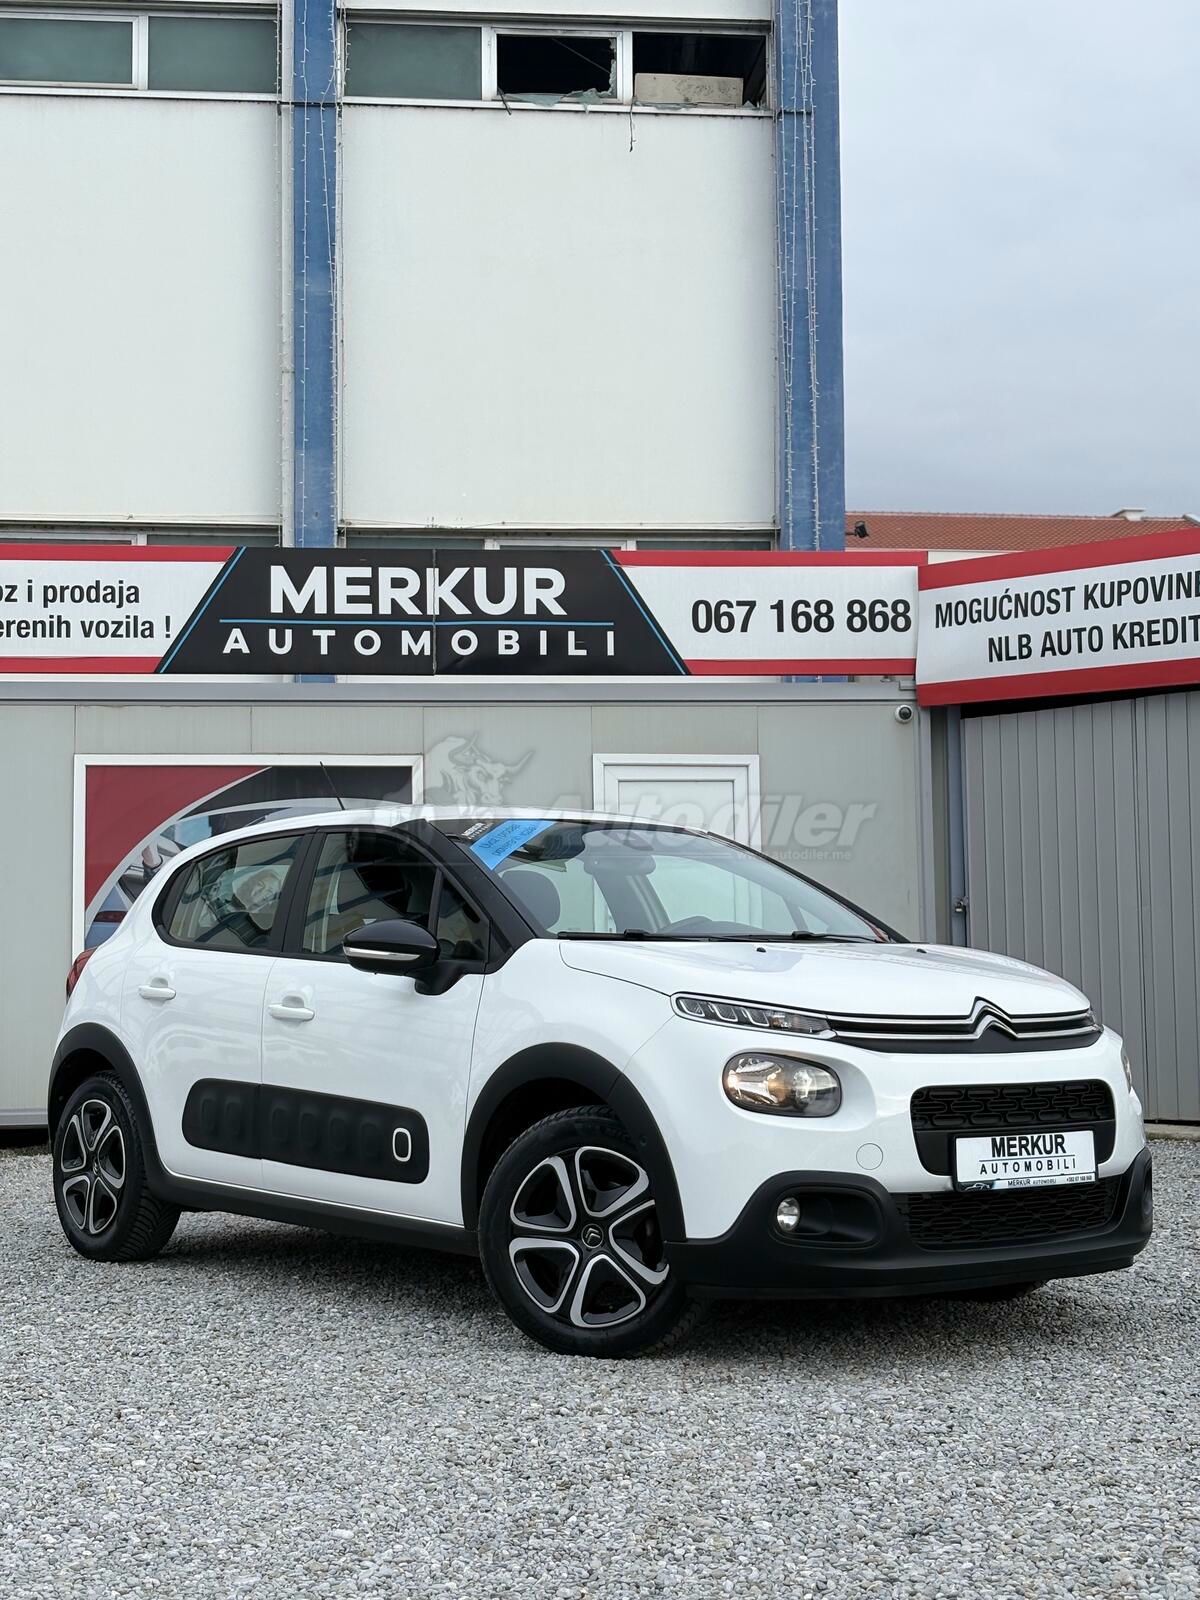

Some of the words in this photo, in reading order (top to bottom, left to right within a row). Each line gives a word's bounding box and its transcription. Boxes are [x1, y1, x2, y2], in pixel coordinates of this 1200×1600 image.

[0, 584, 17, 603] z
[27, 579, 33, 602] i
[43, 579, 139, 608] prodaja
[271, 565, 567, 615] MERKUR
[691, 599, 757, 633] 067
[770, 599, 835, 633] 168
[846, 599, 912, 633] 868
[935, 588, 1075, 629] MOGUĆNOST
[81, 615, 155, 639] vozila
[988, 633, 1032, 662] NLB
[1041, 625, 1103, 657] AUTO
[1113, 614, 1200, 650] KREDIT
[223, 628, 614, 656] AUTOMOBILI
[991, 1133, 1067, 1158] MERKUR
[980, 1158, 1076, 1175] AUTOMOBILI
[1007, 1179, 1031, 1187] MERKUR
